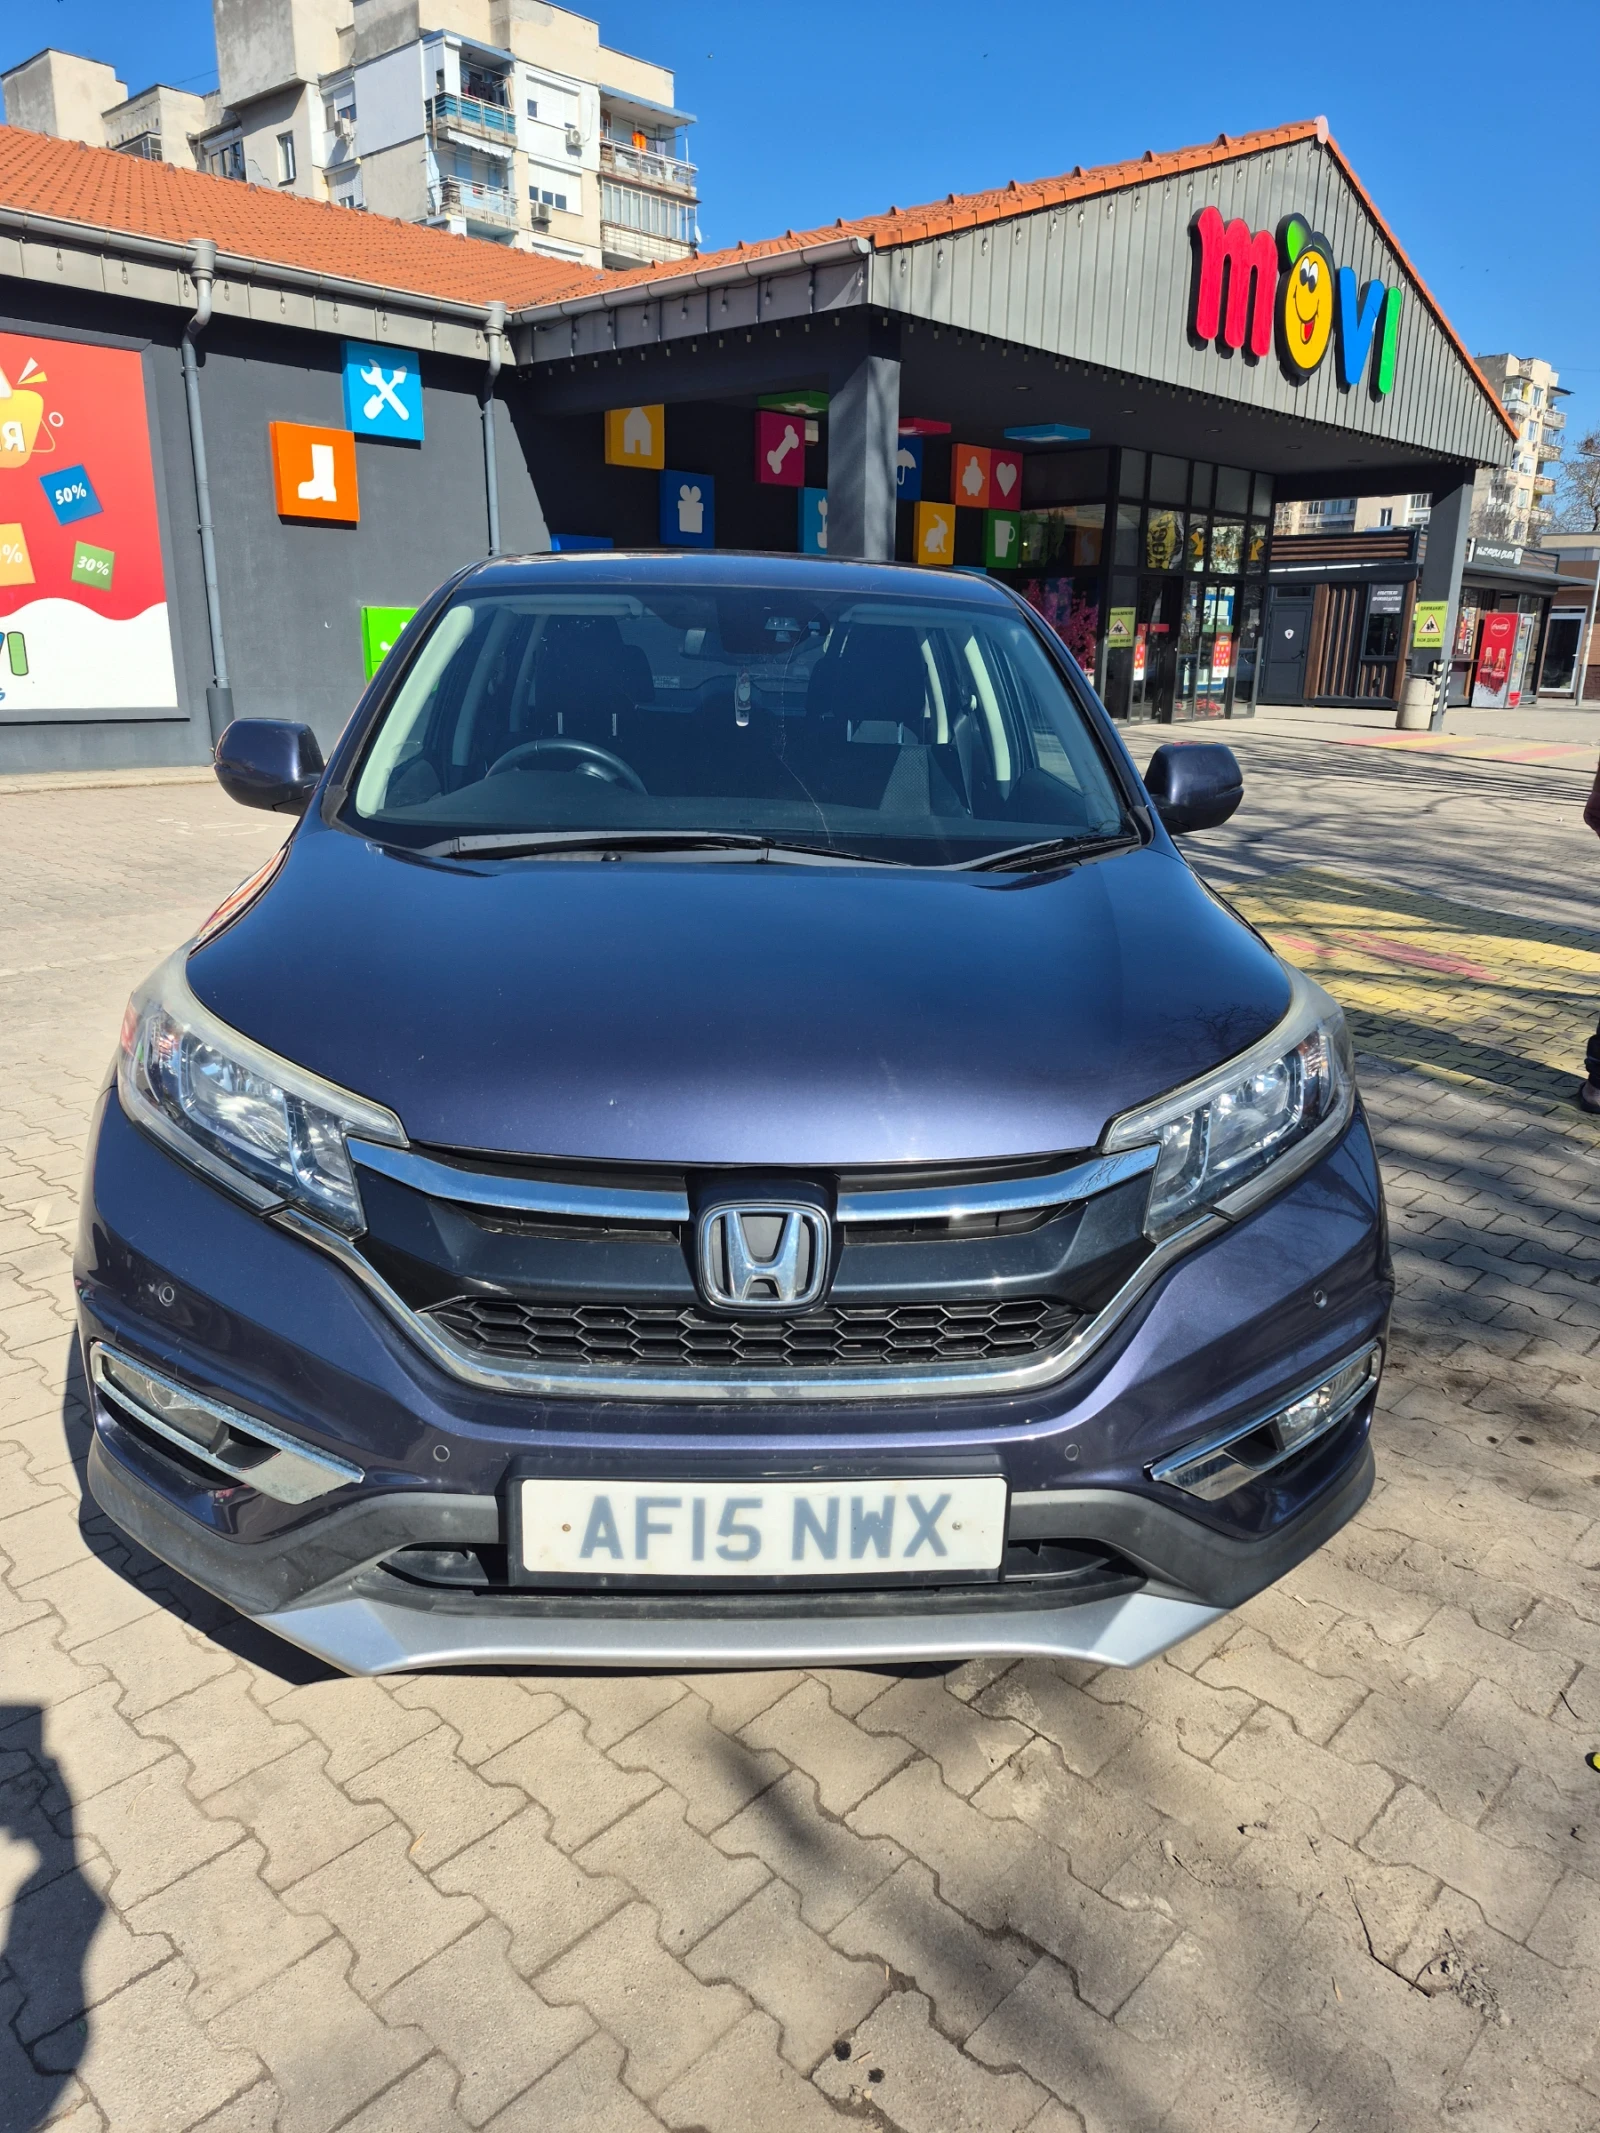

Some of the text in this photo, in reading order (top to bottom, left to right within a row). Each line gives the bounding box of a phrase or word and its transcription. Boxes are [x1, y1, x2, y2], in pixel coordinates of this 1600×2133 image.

[55, 482, 87, 506] 50%
[77, 556, 110, 576] 30%
[579, 1493, 953, 1561] AF15 NWX
